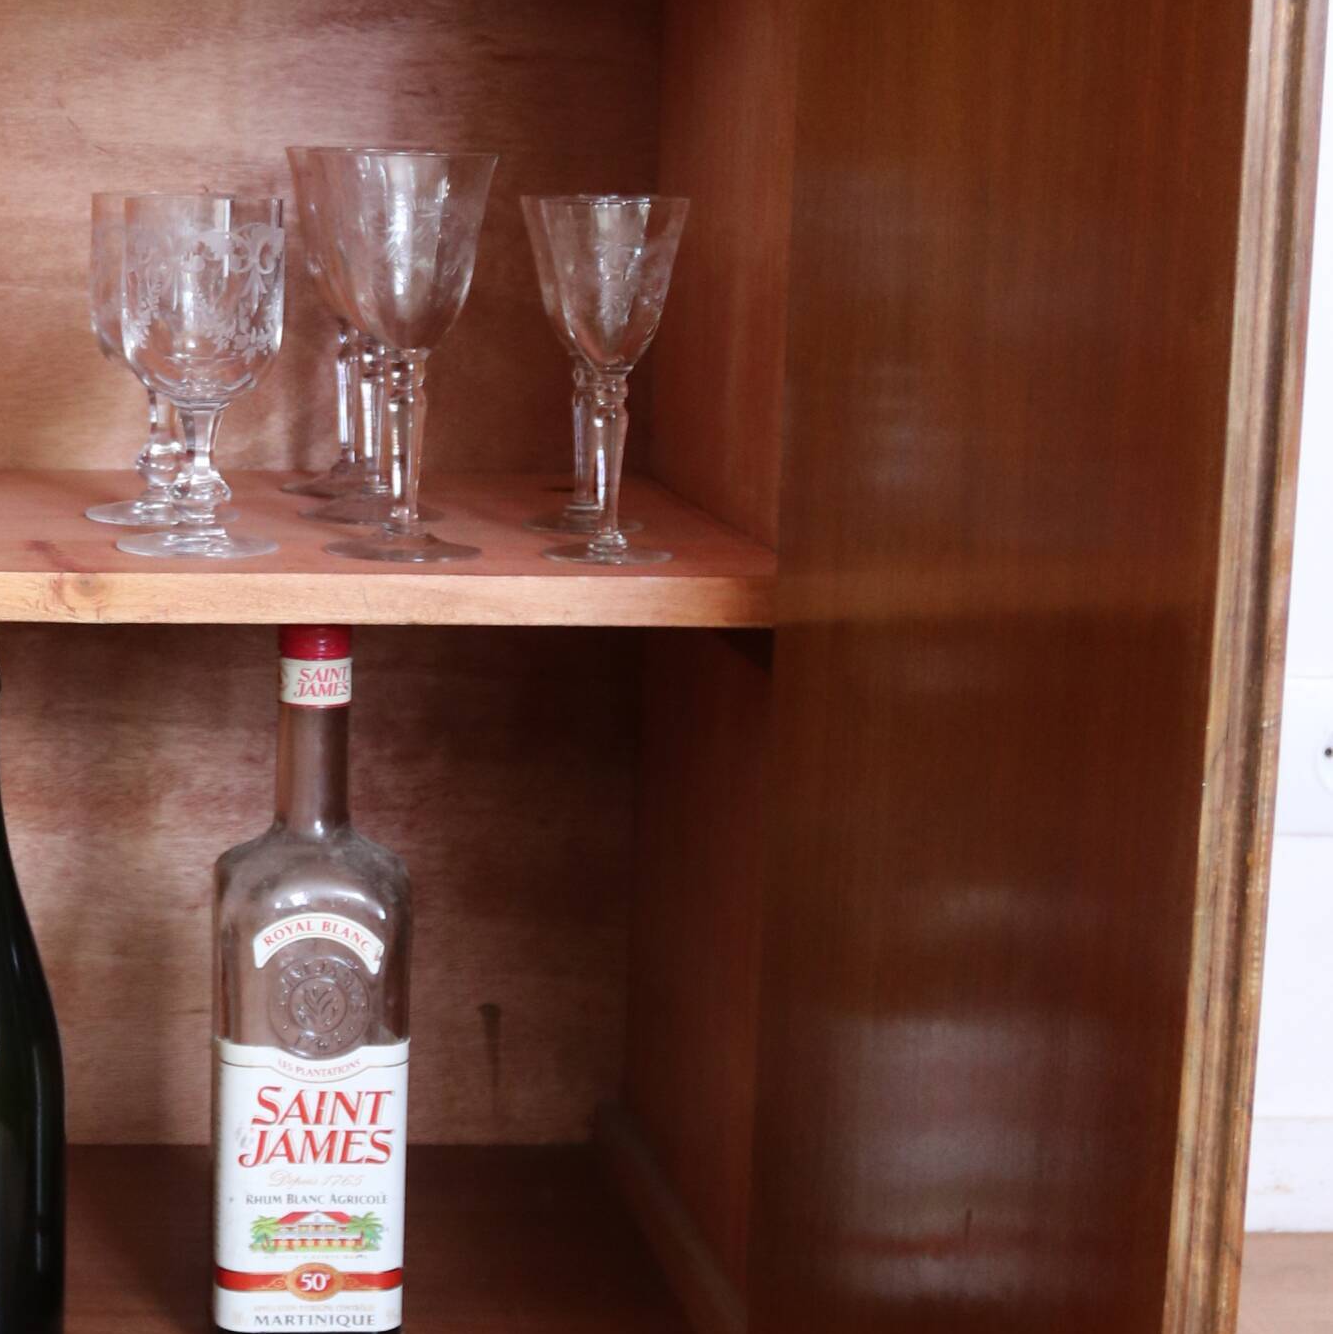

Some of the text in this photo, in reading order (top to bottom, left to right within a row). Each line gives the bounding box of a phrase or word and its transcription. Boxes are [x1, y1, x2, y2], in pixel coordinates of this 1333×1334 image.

[298, 666, 347, 682] SAINT
[293, 681, 349, 698] JAMES
[263, 920, 370, 951] ROYAL BLANC
[251, 1086, 394, 1126] SAINT
[238, 1128, 394, 1167] JAMES
[246, 1193, 388, 1205] RHUM BLANC AGRICOLE
[254, 1314, 376, 1328] MARTINIQUE
